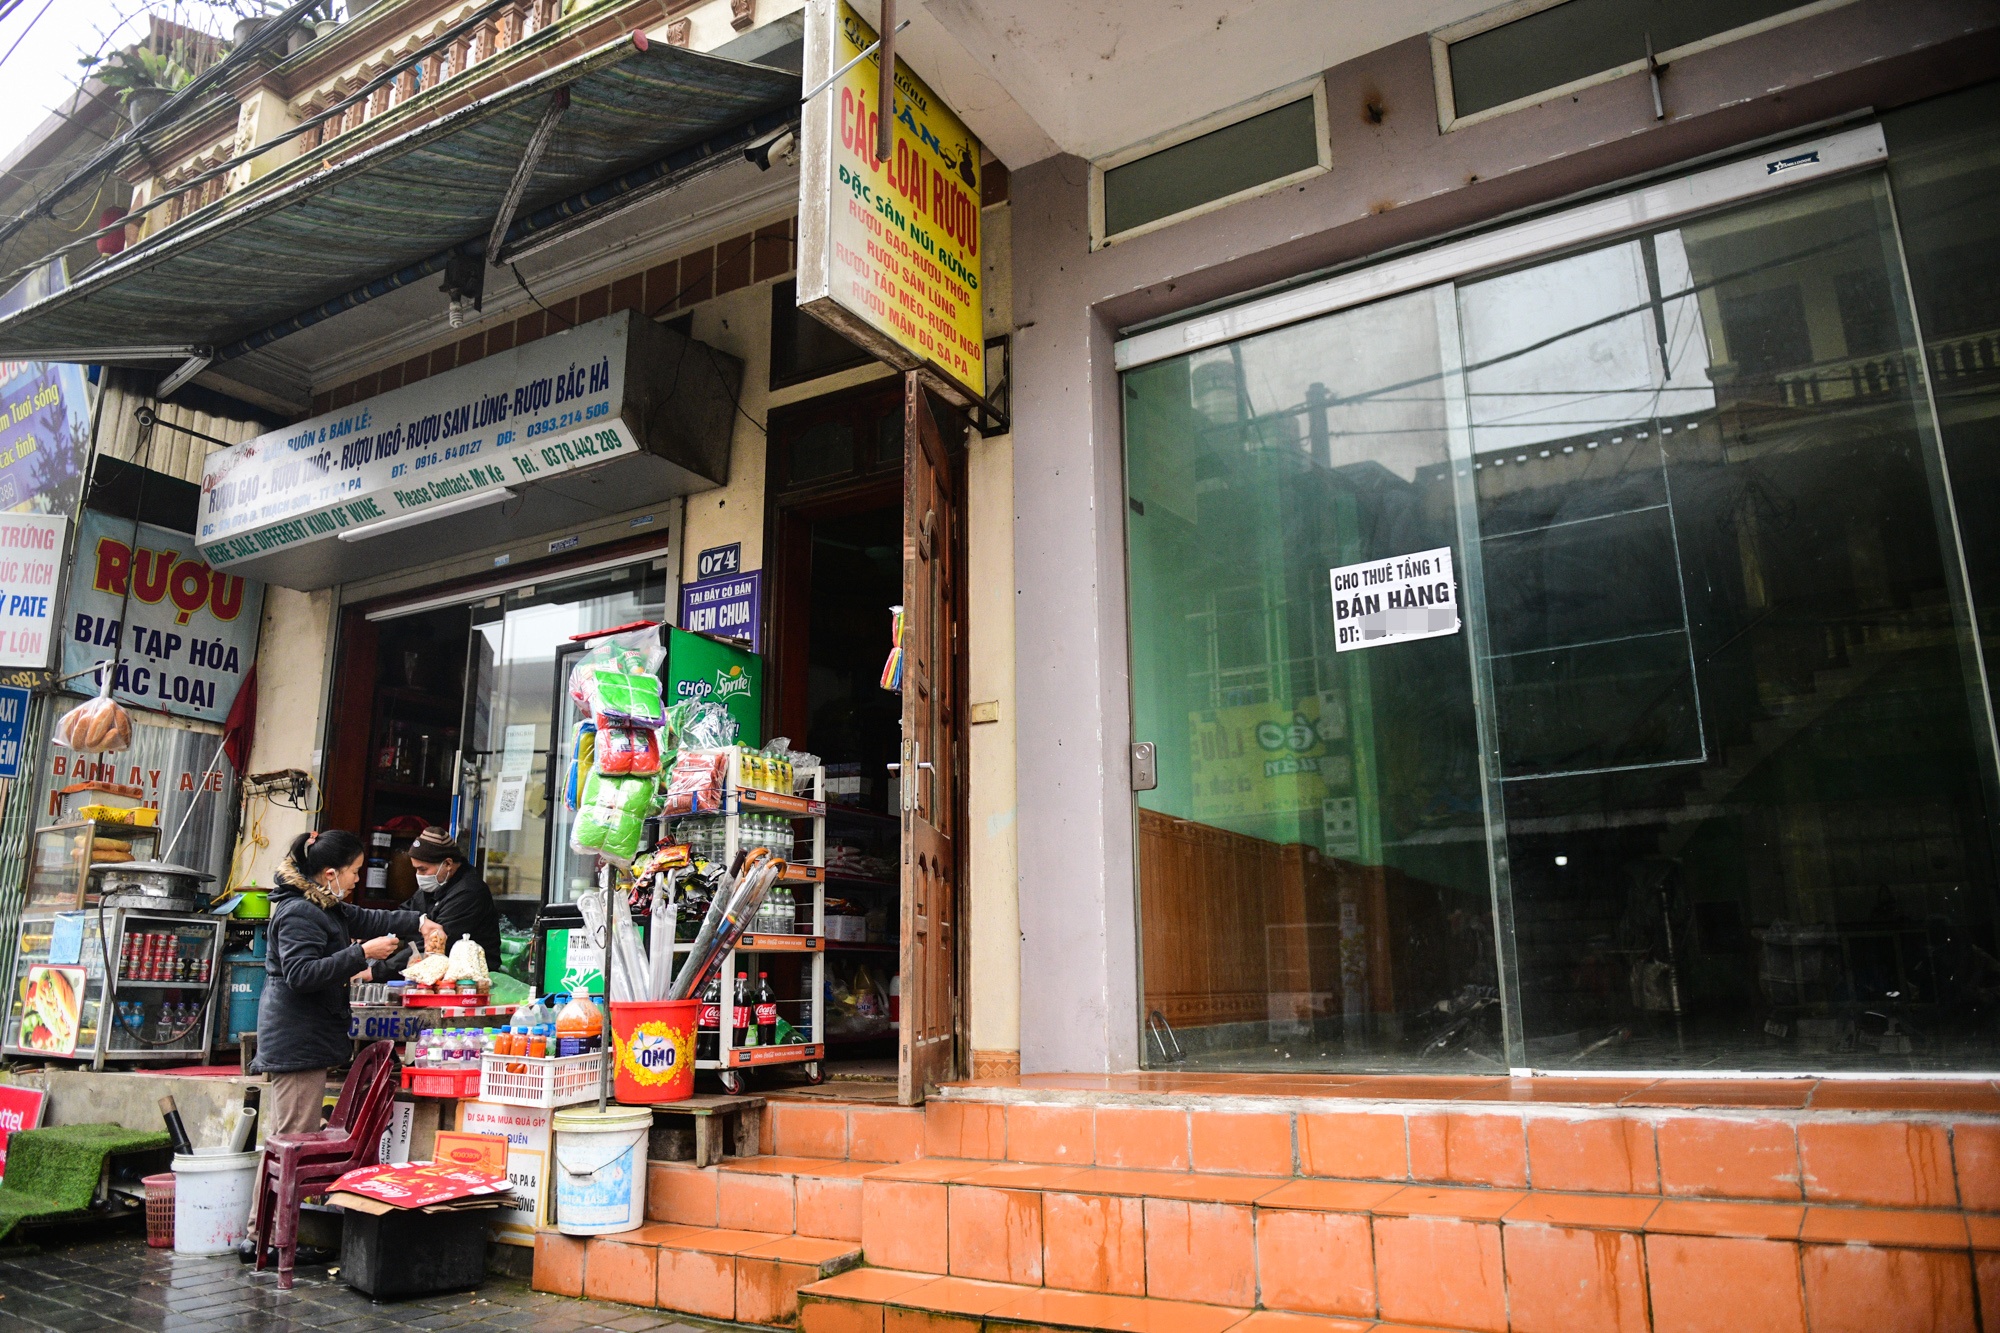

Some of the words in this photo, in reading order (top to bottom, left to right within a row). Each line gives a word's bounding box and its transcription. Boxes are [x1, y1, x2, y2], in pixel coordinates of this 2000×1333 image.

[893, 98, 939, 155] ÁN
[839, 164, 871, 203] ĐẶC
[876, 195, 905, 231] SẢN
[910, 223, 934, 255] NÚI
[939, 247, 978, 290] RỪNG
[933, 168, 977, 260] RƯỢU
[849, 199, 882, 236] RƯỢU
[945, 275, 970, 307] THÓC
[867, 239, 899, 275] RƯỢU
[902, 267, 925, 296] SÁN
[929, 287, 956, 319] LÙNG
[836, 241, 870, 279] RƯỢU
[874, 269, 896, 298] TÁO
[960, 334, 980, 361] NGÔ
[852, 281, 885, 316] RƯỢU
[889, 307, 916, 339] MẬN
[919, 328, 934, 351] ĐỎ
[937, 342, 951, 364] SA
[954, 354, 968, 376] PA
[34, 383, 59, 411] sống
[15, 432, 37, 459] tỉnh
[209, 482, 237, 515] RƯỢU
[238, 475, 260, 507] GẠO
[271, 461, 300, 494] RƯỢU
[303, 448, 331, 483] THÓC
[341, 436, 374, 471] RƯỢU
[442, 404, 470, 439] SAN
[555, 362, 586, 404] BẮC
[589, 355, 609, 394] HÀ
[288, 430, 316, 451] BUÔN
[318, 427, 327, 443] &
[329, 418, 353, 440] BÁN
[348, 477, 362, 491] PA
[391, 463, 408, 479] ĐT:
[496, 430, 517, 447] DĐ:
[203, 542, 236, 565] HERE
[229, 536, 260, 558] SALE
[252, 519, 310, 551] DIFFERENT
[304, 511, 337, 535] KIND
[332, 507, 351, 528] OF
[345, 497, 387, 523] WINE.
[393, 486, 432, 509] Please
[427, 473, 474, 499] Contact:
[468, 468, 490, 488] Mr
[484, 464, 506, 483] Ke
[512, 454, 540, 476] Tel.
[594, 428, 623, 452] 289
[1, 523, 55, 551] TRỨNG
[21, 559, 53, 585] XÍCH
[700, 549, 737, 575] 074
[1334, 572, 1359, 592] CHO
[1362, 562, 1394, 586] THUÊ
[1397, 556, 1431, 580] TẦNG
[1434, 557, 1441, 573] 1
[92, 536, 247, 627] RƯỢU
[690, 592, 703, 605] TẠI
[704, 587, 720, 601] ĐÂY
[722, 584, 733, 598] CÓ
[734, 581, 752, 596] BÁN
[9, 595, 49, 618] PATE
[690, 607, 717, 631] NEM
[719, 601, 750, 628] CHUA
[1336, 592, 1381, 621] BÁN
[1387, 582, 1450, 609] HÀNG
[9, 627, 43, 658] LỘN
[74, 613, 121, 649] BIA
[132, 625, 182, 664] TẠP
[189, 637, 239, 675] HÓA
[1339, 626, 1360, 644] ĐT:
[158, 672, 216, 712] LOẠI
[677, 678, 712, 697] CHỚP
[717, 674, 748, 697] Sprite
[52, 755, 116, 784] BÁNH
[231, 983, 253, 993] ROL
[642, 1048, 676, 1068] OMO
[476, 1113, 485, 1122] SA
[487, 1114, 496, 1123] PA
[497, 1115, 513, 1125] MUA
[519, 1174, 529, 1187] PA
[531, 1175, 537, 1188] &
